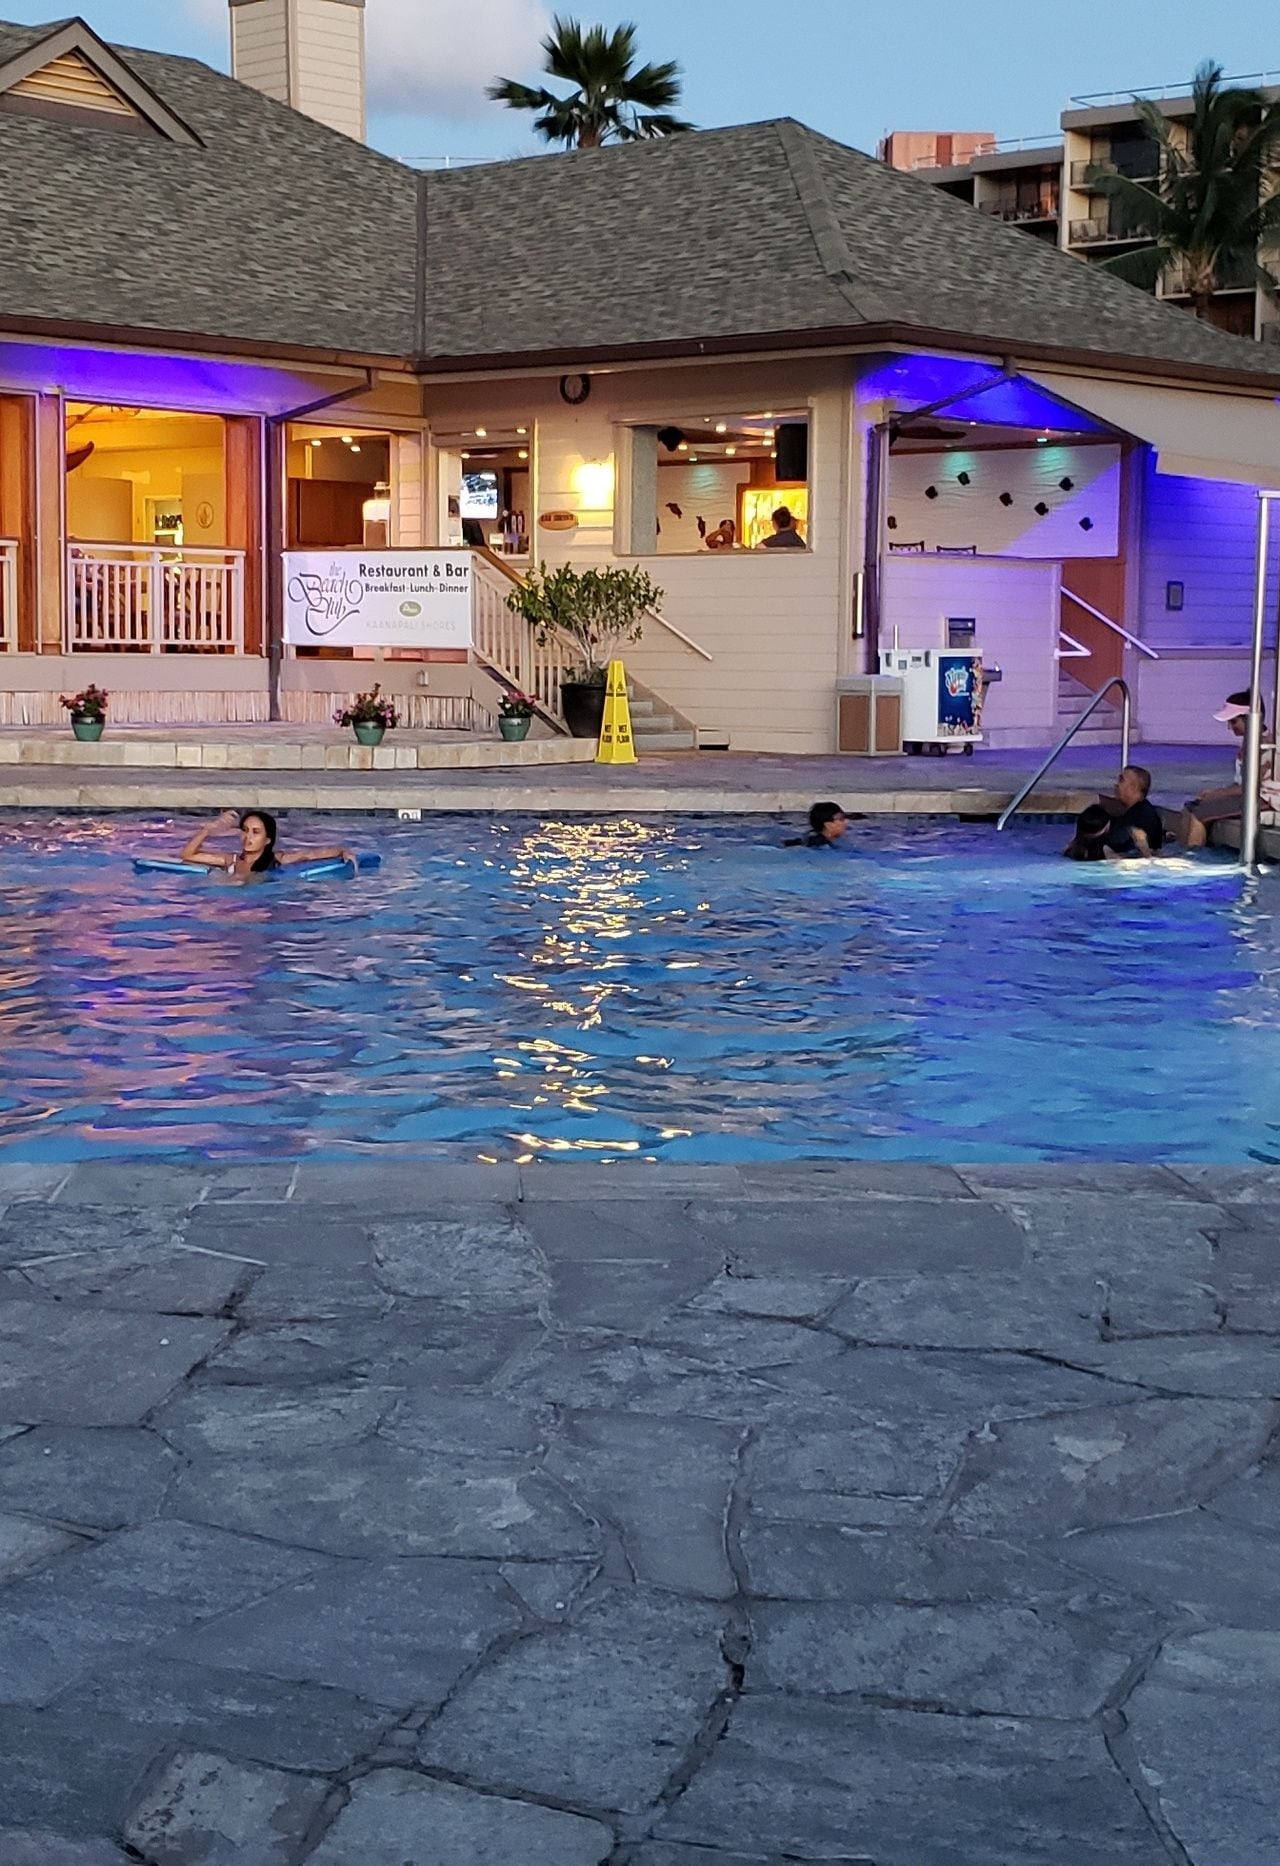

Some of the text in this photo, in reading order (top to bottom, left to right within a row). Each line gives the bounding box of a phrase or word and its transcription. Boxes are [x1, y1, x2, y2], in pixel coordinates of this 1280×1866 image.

[359, 563, 469, 578] Restaurant & Bar
